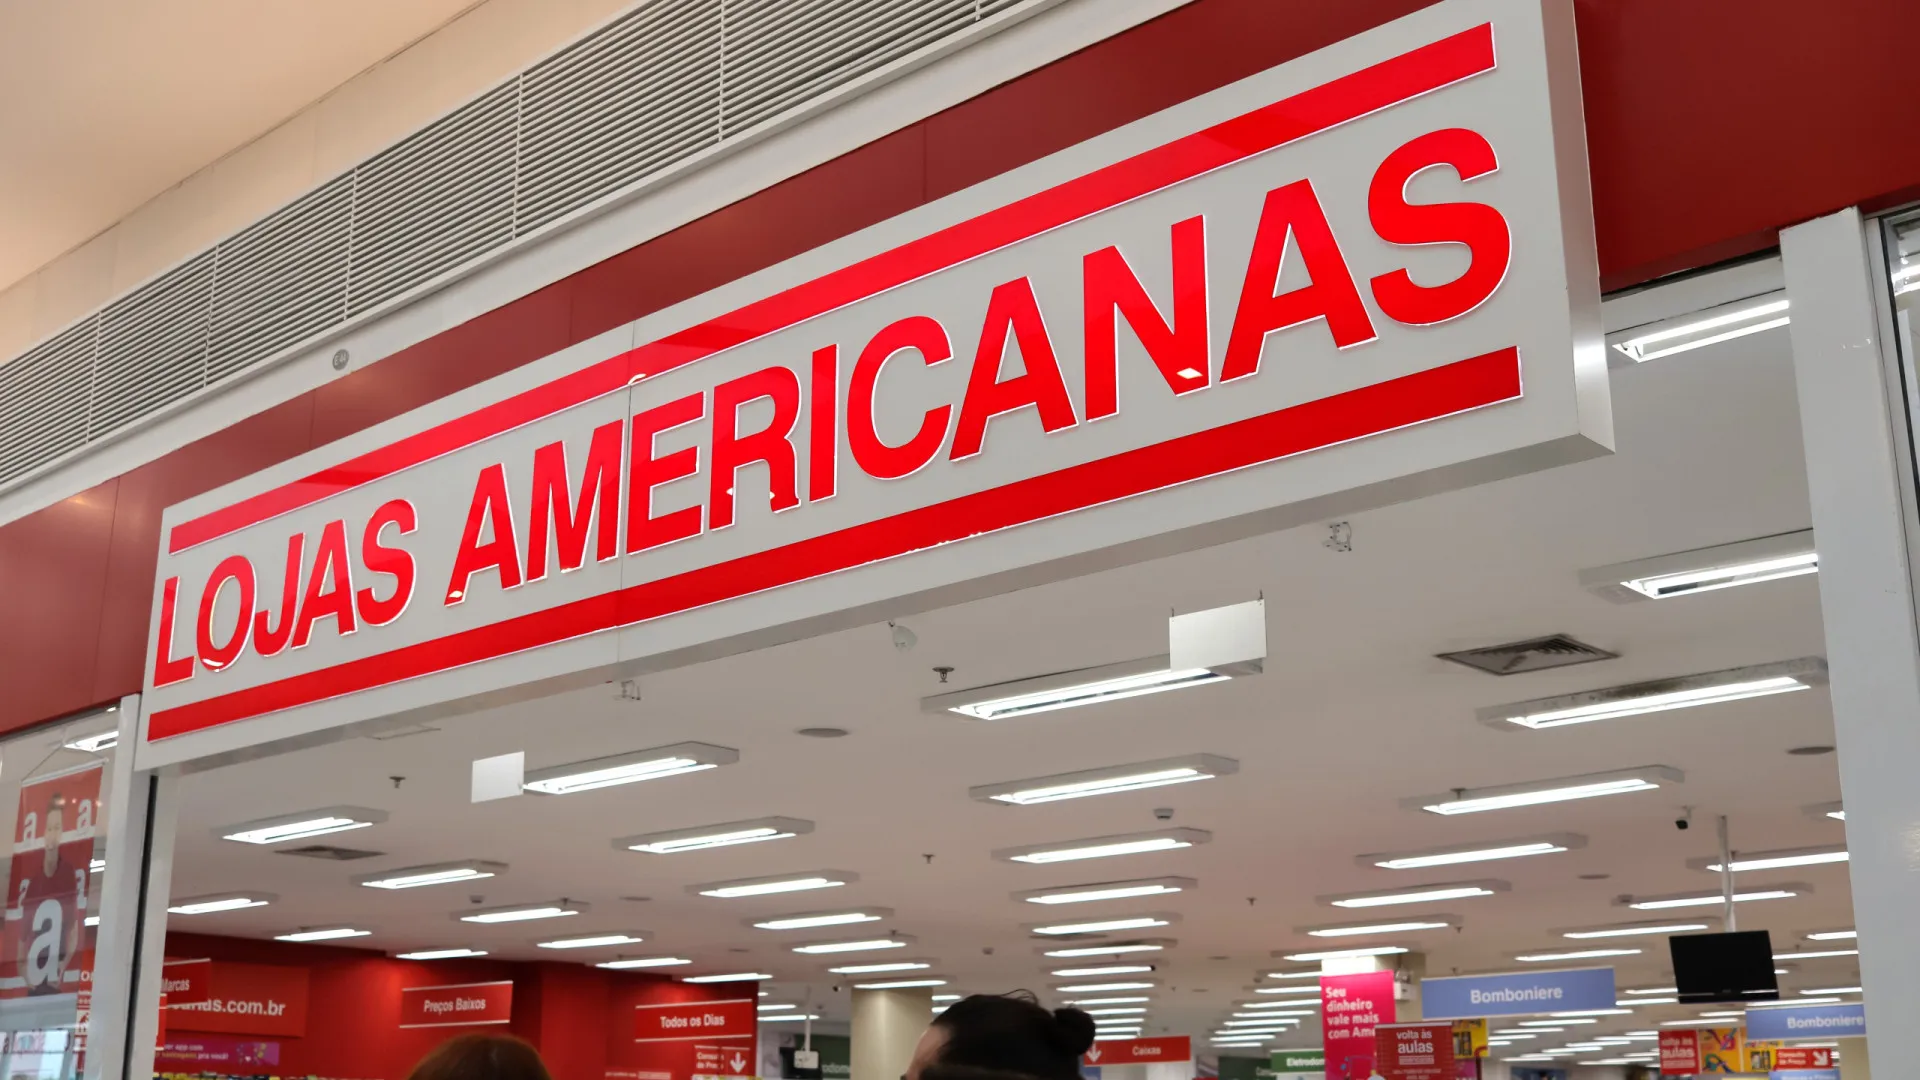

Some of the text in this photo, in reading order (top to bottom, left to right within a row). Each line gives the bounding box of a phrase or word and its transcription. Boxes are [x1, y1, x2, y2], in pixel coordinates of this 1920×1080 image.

[154, 127, 1512, 688] LOJAS AMERICANAS
[77, 799, 91, 830] a
[24, 812, 37, 841] a
[27, 899, 63, 986] a
[1325, 987, 1347, 998] Seu
[1470, 985, 1563, 1004] Bomboniere
[424, 997, 486, 1015] Preços Baixos
[1326, 998, 1373, 1012] dinheiro
[660, 1013, 725, 1028] Todos os Dias
[1327, 1012, 1380, 1025] vale mais
[1787, 1016, 1864, 1029] Bomboniere
[1328, 1029, 1350, 1039] com
[1396, 1028, 1432, 1039] volta às
[1132, 1045, 1161, 1056] Caixas
[1398, 1041, 1434, 1053] aulas
[1662, 1046, 1696, 1058] aulas
